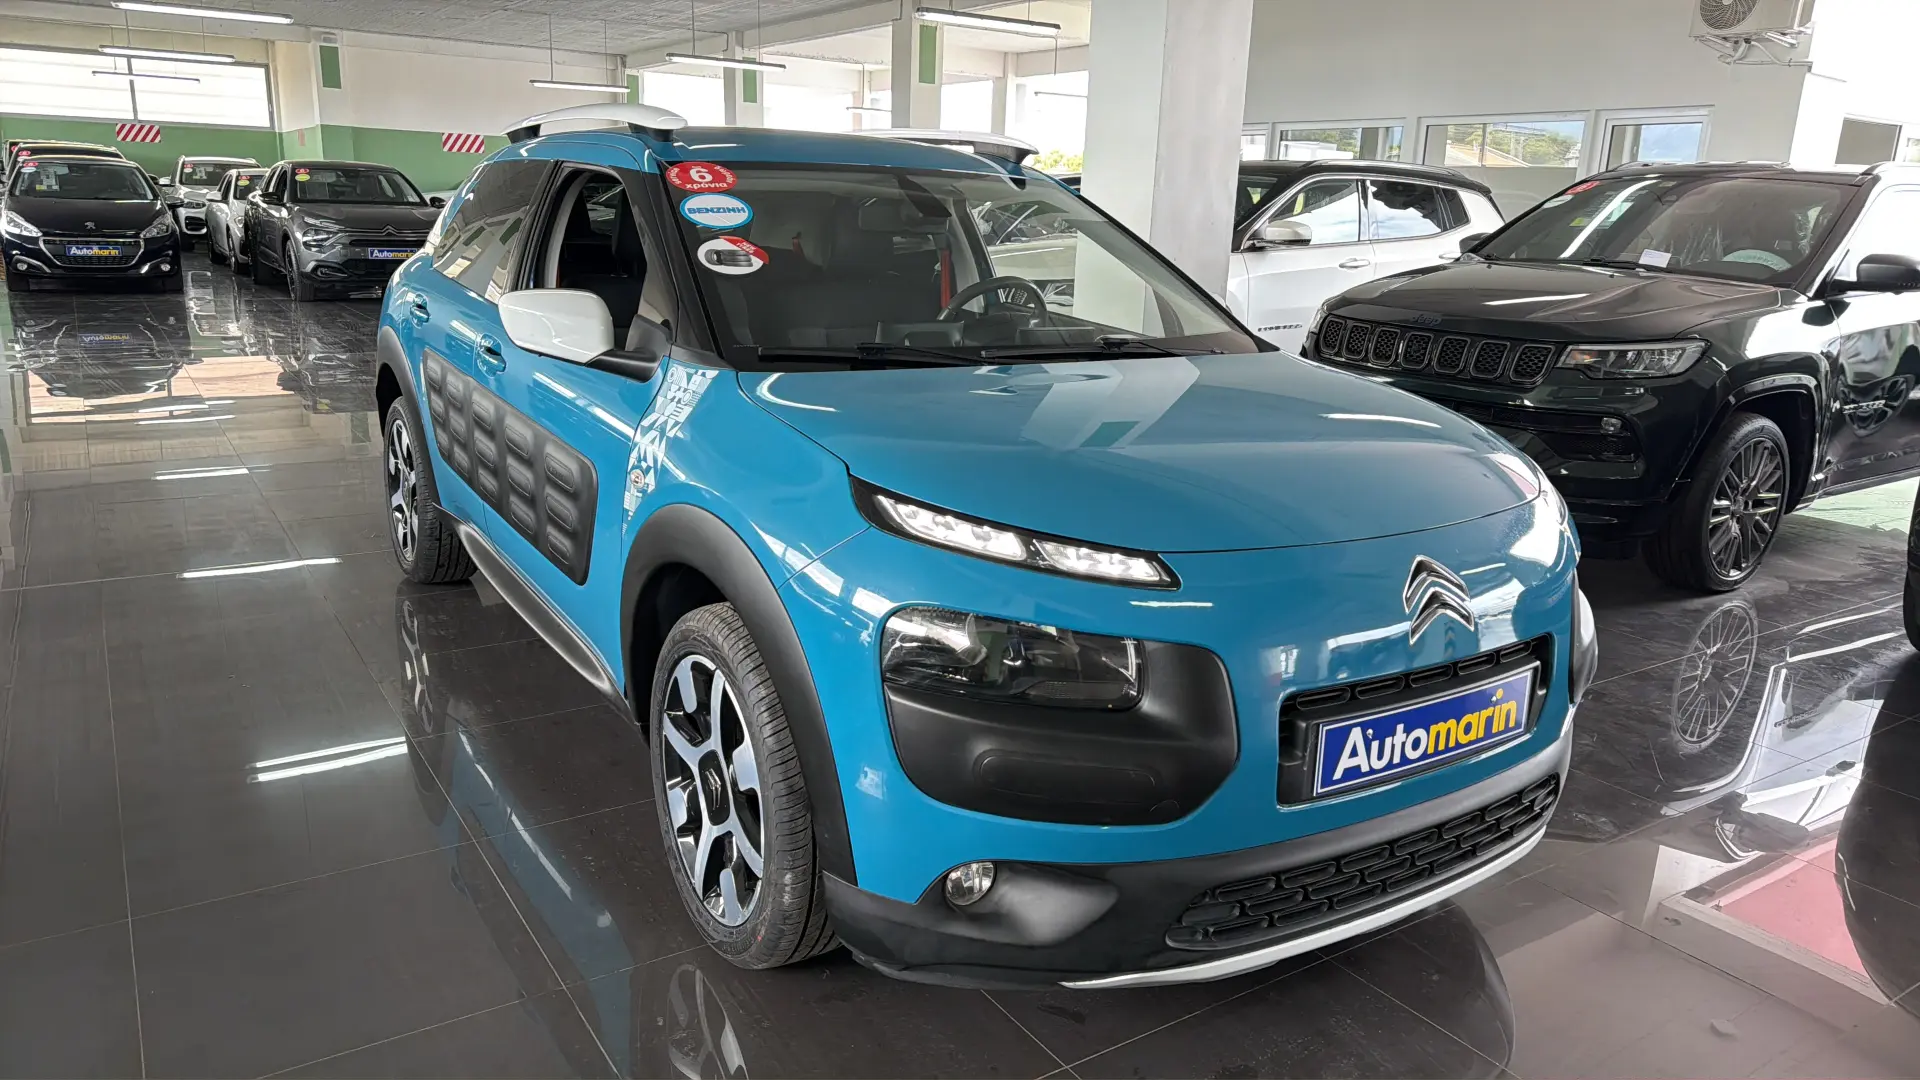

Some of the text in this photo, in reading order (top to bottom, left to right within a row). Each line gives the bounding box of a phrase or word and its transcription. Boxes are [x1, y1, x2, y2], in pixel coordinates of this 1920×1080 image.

[689, 167, 713, 183] 6
[685, 182, 728, 190] χρόνια
[70, 247, 119, 255] Automarin
[1332, 688, 1518, 781] Automarin
